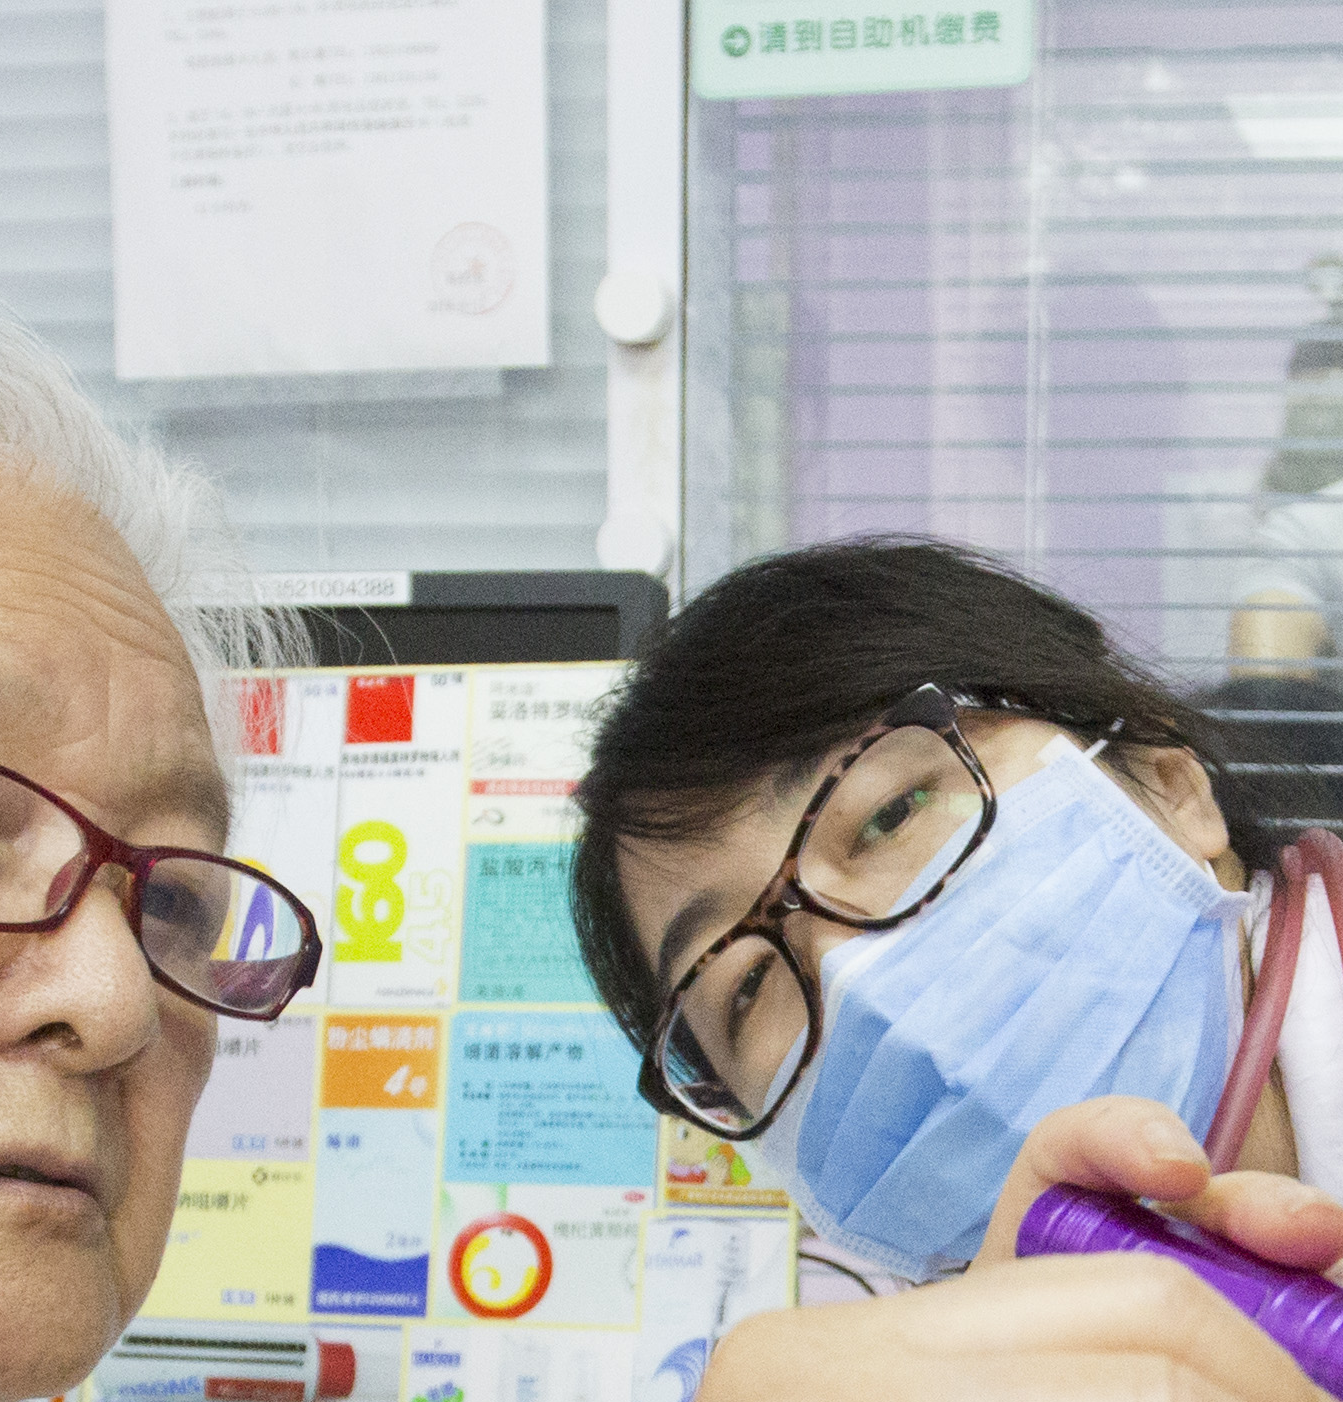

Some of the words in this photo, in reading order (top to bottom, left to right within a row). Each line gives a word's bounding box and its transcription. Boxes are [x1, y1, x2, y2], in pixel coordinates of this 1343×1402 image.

[759, 10, 1001, 53] 请到自助机缴费
[334, 820, 407, 962] 160
[327, 1025, 435, 1051] 粉尘螨滴剂
